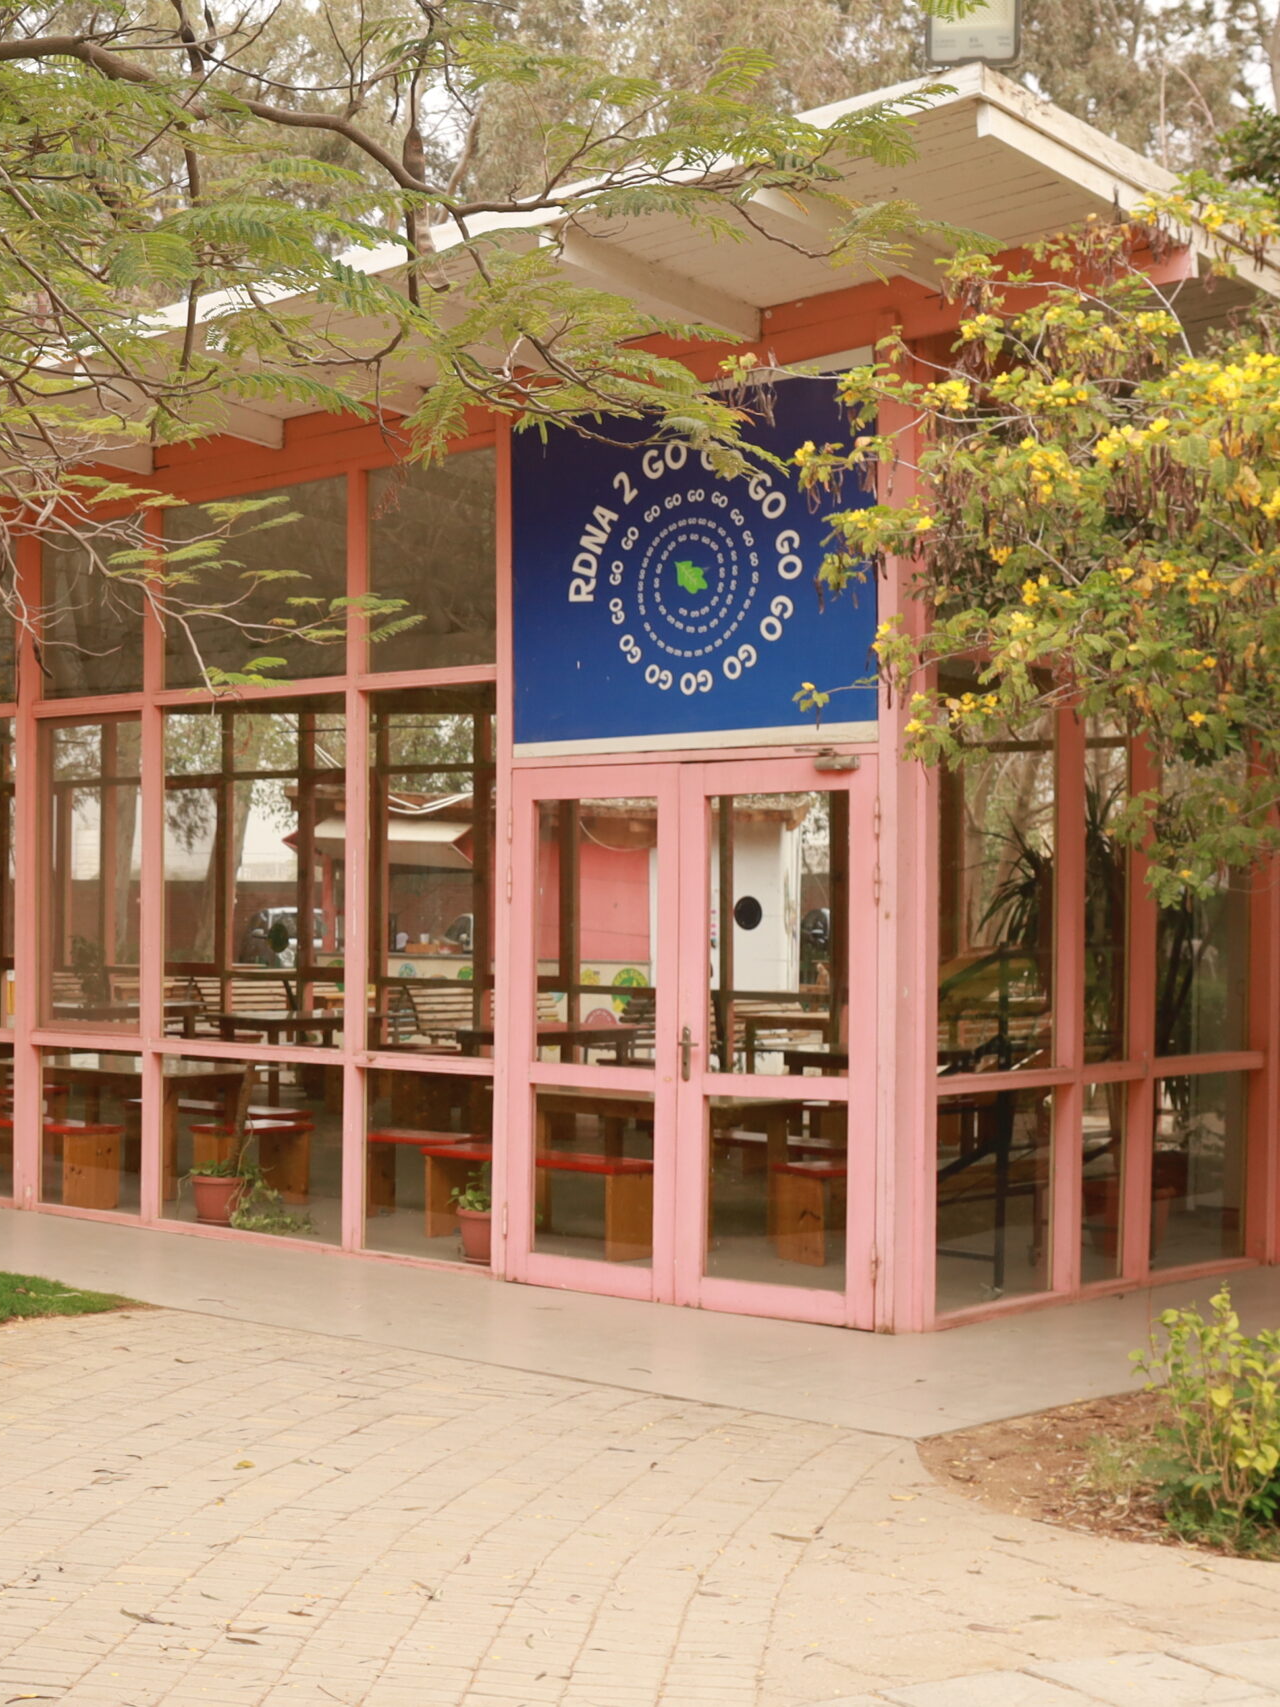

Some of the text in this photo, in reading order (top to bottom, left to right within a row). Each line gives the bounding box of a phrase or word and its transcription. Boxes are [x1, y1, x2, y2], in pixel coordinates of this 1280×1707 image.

[642, 441, 687, 480] GO
[613, 472, 638, 504] 2
[664, 493, 682, 509] GO
[687, 489, 705, 502] GO
[711, 491, 728, 508] GO
[748, 472, 787, 519] GO
[644, 505, 660, 523] GO
[730, 509, 744, 526] GO
[621, 527, 639, 550] GO
[742, 530, 754, 547] GO
[568, 505, 619, 602] RDNA
[749, 552, 759, 567] GO
[775, 529, 803, 580] GO
[609, 560, 624, 585] GO
[609, 598, 625, 625] GO
[760, 595, 794, 641] GO
[619, 634, 642, 664] GO
[723, 644, 757, 680] GO
[645, 664, 673, 690] GO
[680, 669, 713, 696] GO
